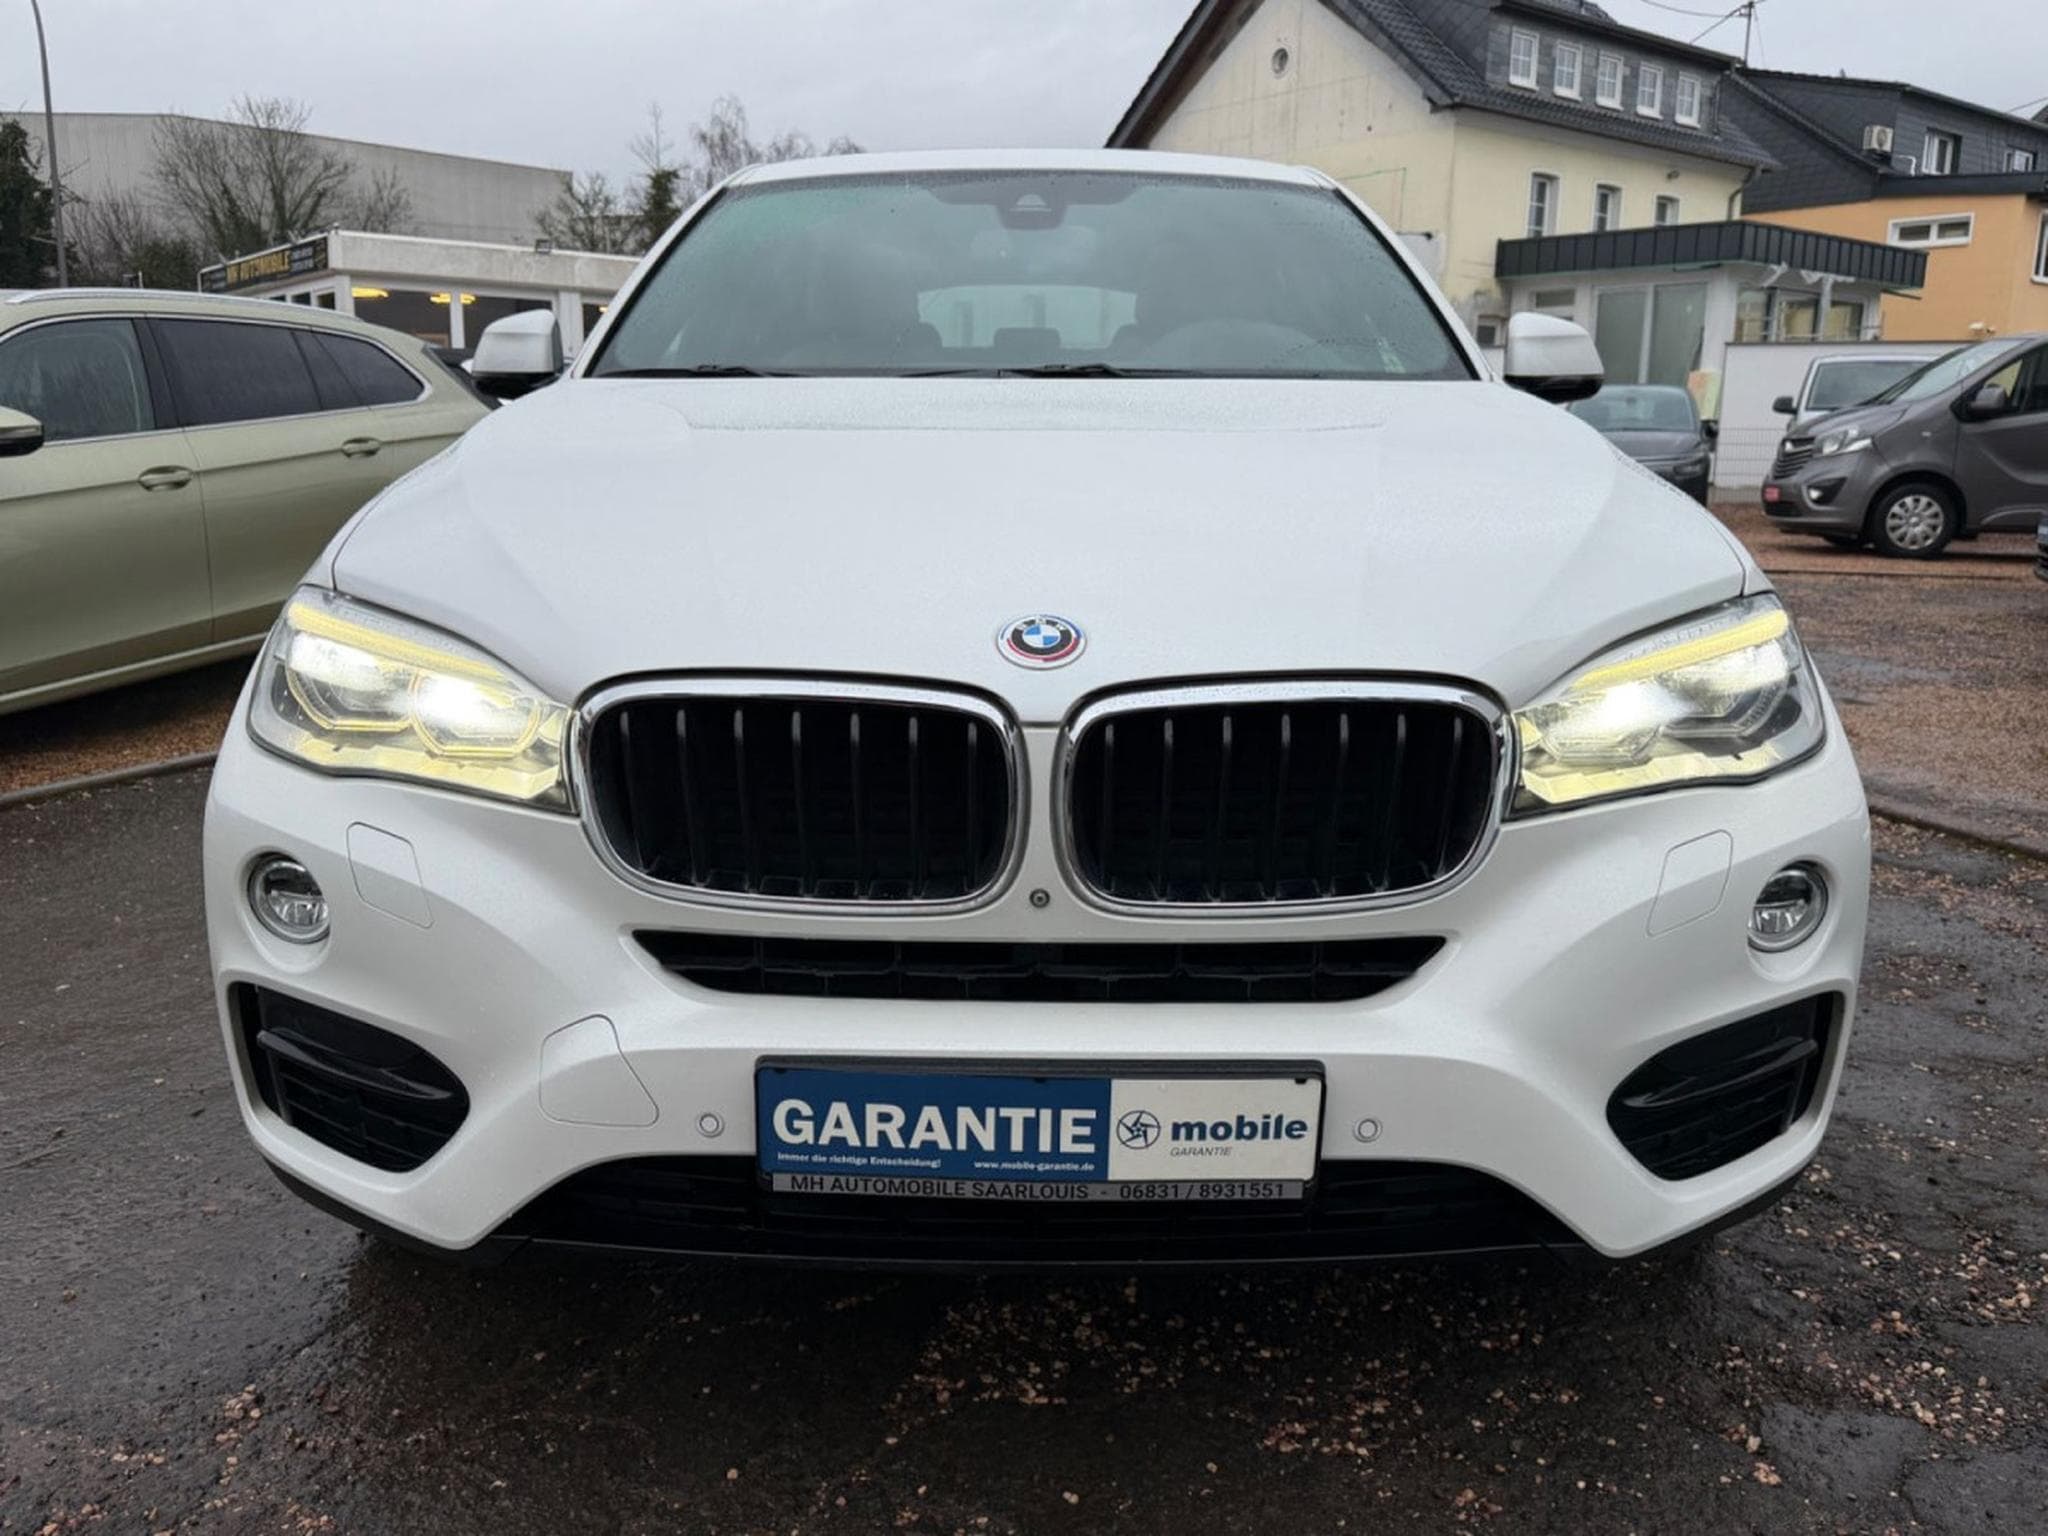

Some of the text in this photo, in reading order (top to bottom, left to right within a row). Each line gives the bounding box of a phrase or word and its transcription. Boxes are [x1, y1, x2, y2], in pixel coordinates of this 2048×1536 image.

[772, 1098, 1097, 1154] GARANTIE
[1170, 1114, 1308, 1141] mobile
[777, 1152, 942, 1169] Immer die richtige Entscheidung!
[1170, 1146, 1233, 1157] GARANTIE
[974, 1160, 1095, 1171] www.mobile-garantie.de
[790, 1175, 824, 1191] MH
[830, 1177, 966, 1197] AUTOMOBILE
[972, 1182, 1089, 1199] SAARLOUIS
